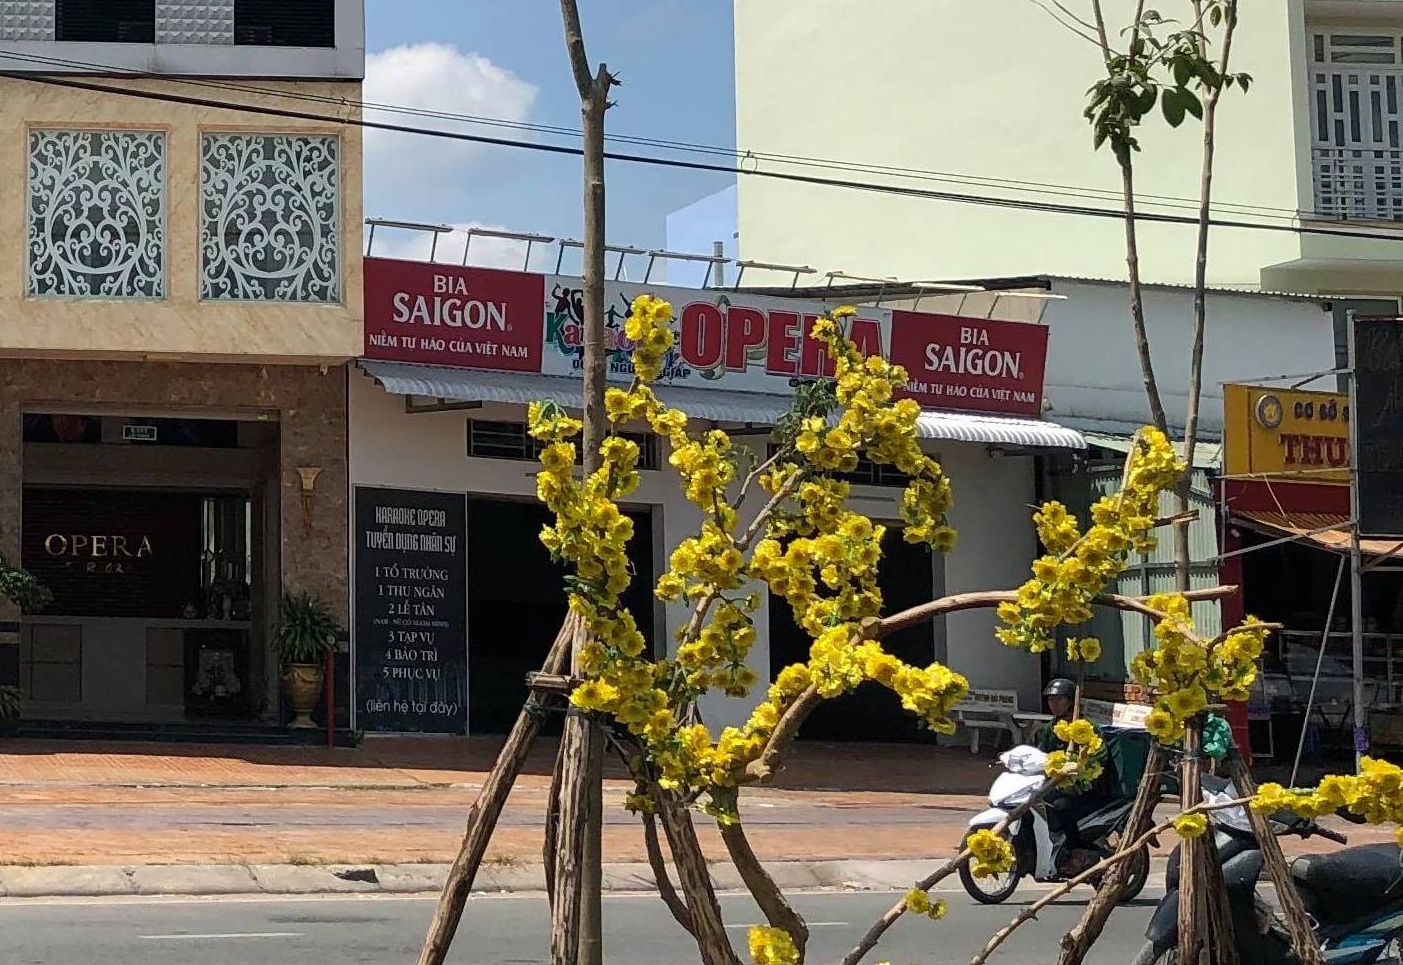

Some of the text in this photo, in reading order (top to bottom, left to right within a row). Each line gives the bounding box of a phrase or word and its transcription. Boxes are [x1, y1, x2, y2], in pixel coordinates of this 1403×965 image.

[433, 275, 468, 295] BIA
[393, 292, 507, 331] SAIGON
[368, 330, 397, 347] NIỀM
[420, 337, 445, 351] HÀO
[448, 337, 473, 353] CỦA
[501, 345, 527, 358] NAM
[960, 327, 989, 346] BIA
[925, 343, 1020, 378] SAIGON
[946, 384, 967, 397] HÀO
[970, 384, 989, 399] CỦA
[1013, 392, 1035, 403] NAM
[375, 506, 446, 527] KARAOKE OPERA
[44, 533, 153, 557] OPERA
[375, 567, 380, 578] 1
[378, 585, 384, 596] 1
[387, 585, 411, 597] THU
[388, 603, 395, 614] 2
[388, 630, 395, 643] 3
[382, 666, 389, 678] 5
